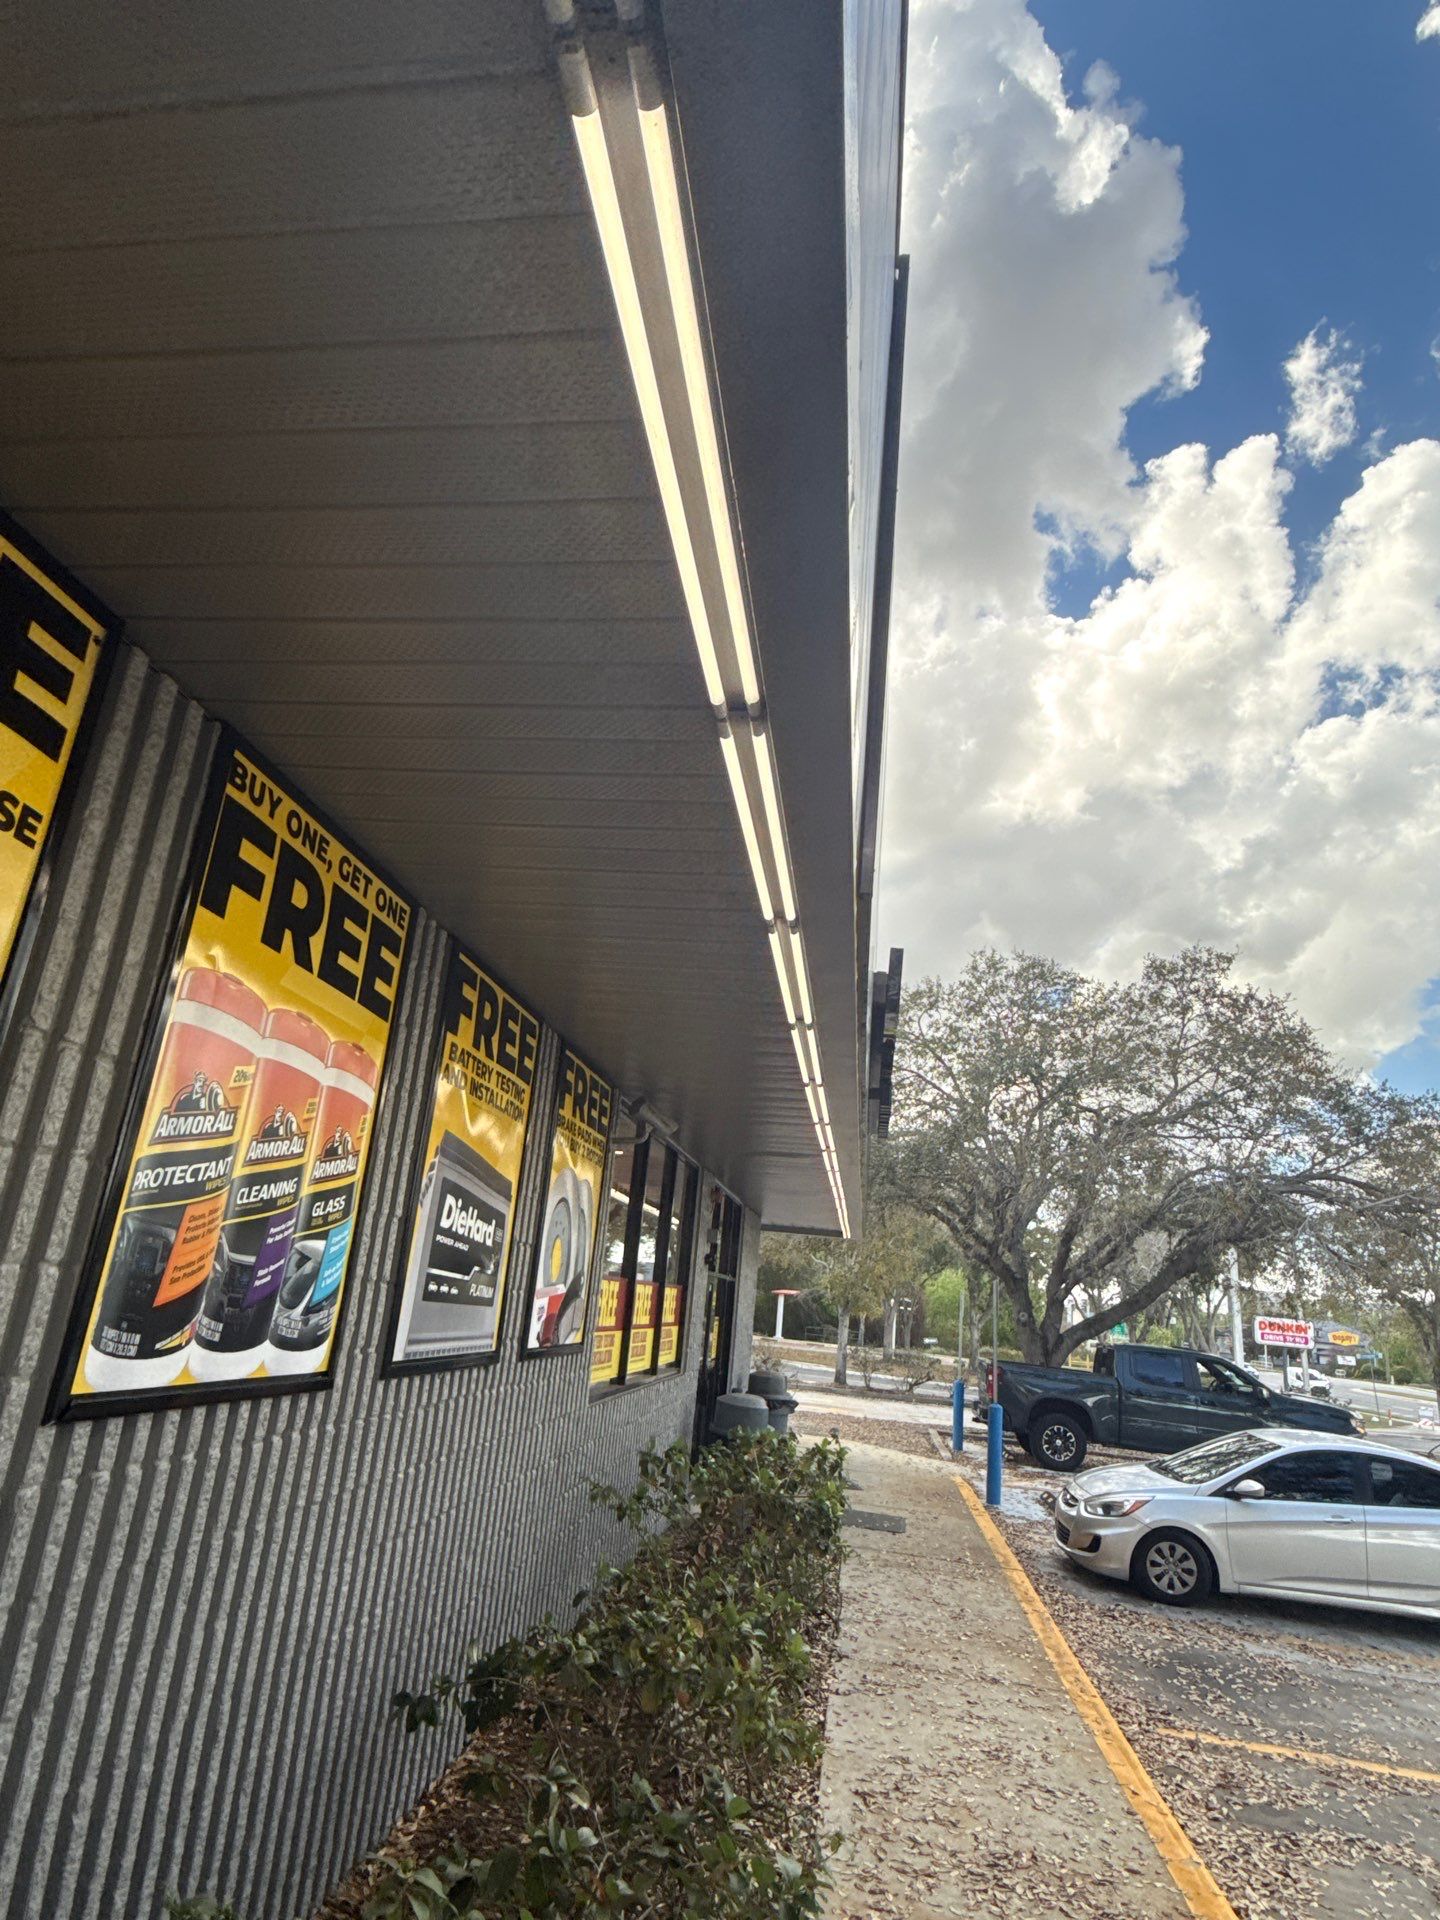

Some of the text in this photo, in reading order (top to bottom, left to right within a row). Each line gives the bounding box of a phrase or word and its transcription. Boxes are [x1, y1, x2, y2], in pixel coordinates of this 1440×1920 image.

[229, 757, 407, 931] BUY ONE, GET ONE
[200, 792, 402, 1020] FREE
[446, 957, 537, 1087] FREE
[441, 1063, 525, 1124] AND INSTALLATION
[449, 1042, 526, 1105] BATTERY TESTING
[558, 1053, 609, 1138] FREE
[132, 1156, 233, 1191] PROTECTANT
[236, 1177, 297, 1204] CLEANING
[312, 1195, 346, 1217] GLASS
[440, 1193, 496, 1247] DieHard
[436, 1234, 469, 1251] POWER AHEAD
[469, 1283, 494, 1298] PLATINUM
[633, 1284, 653, 1325] FREE
[1259, 1321, 1311, 1334] DUNKIN'
[1263, 1333, 1284, 1341] DRIVE
